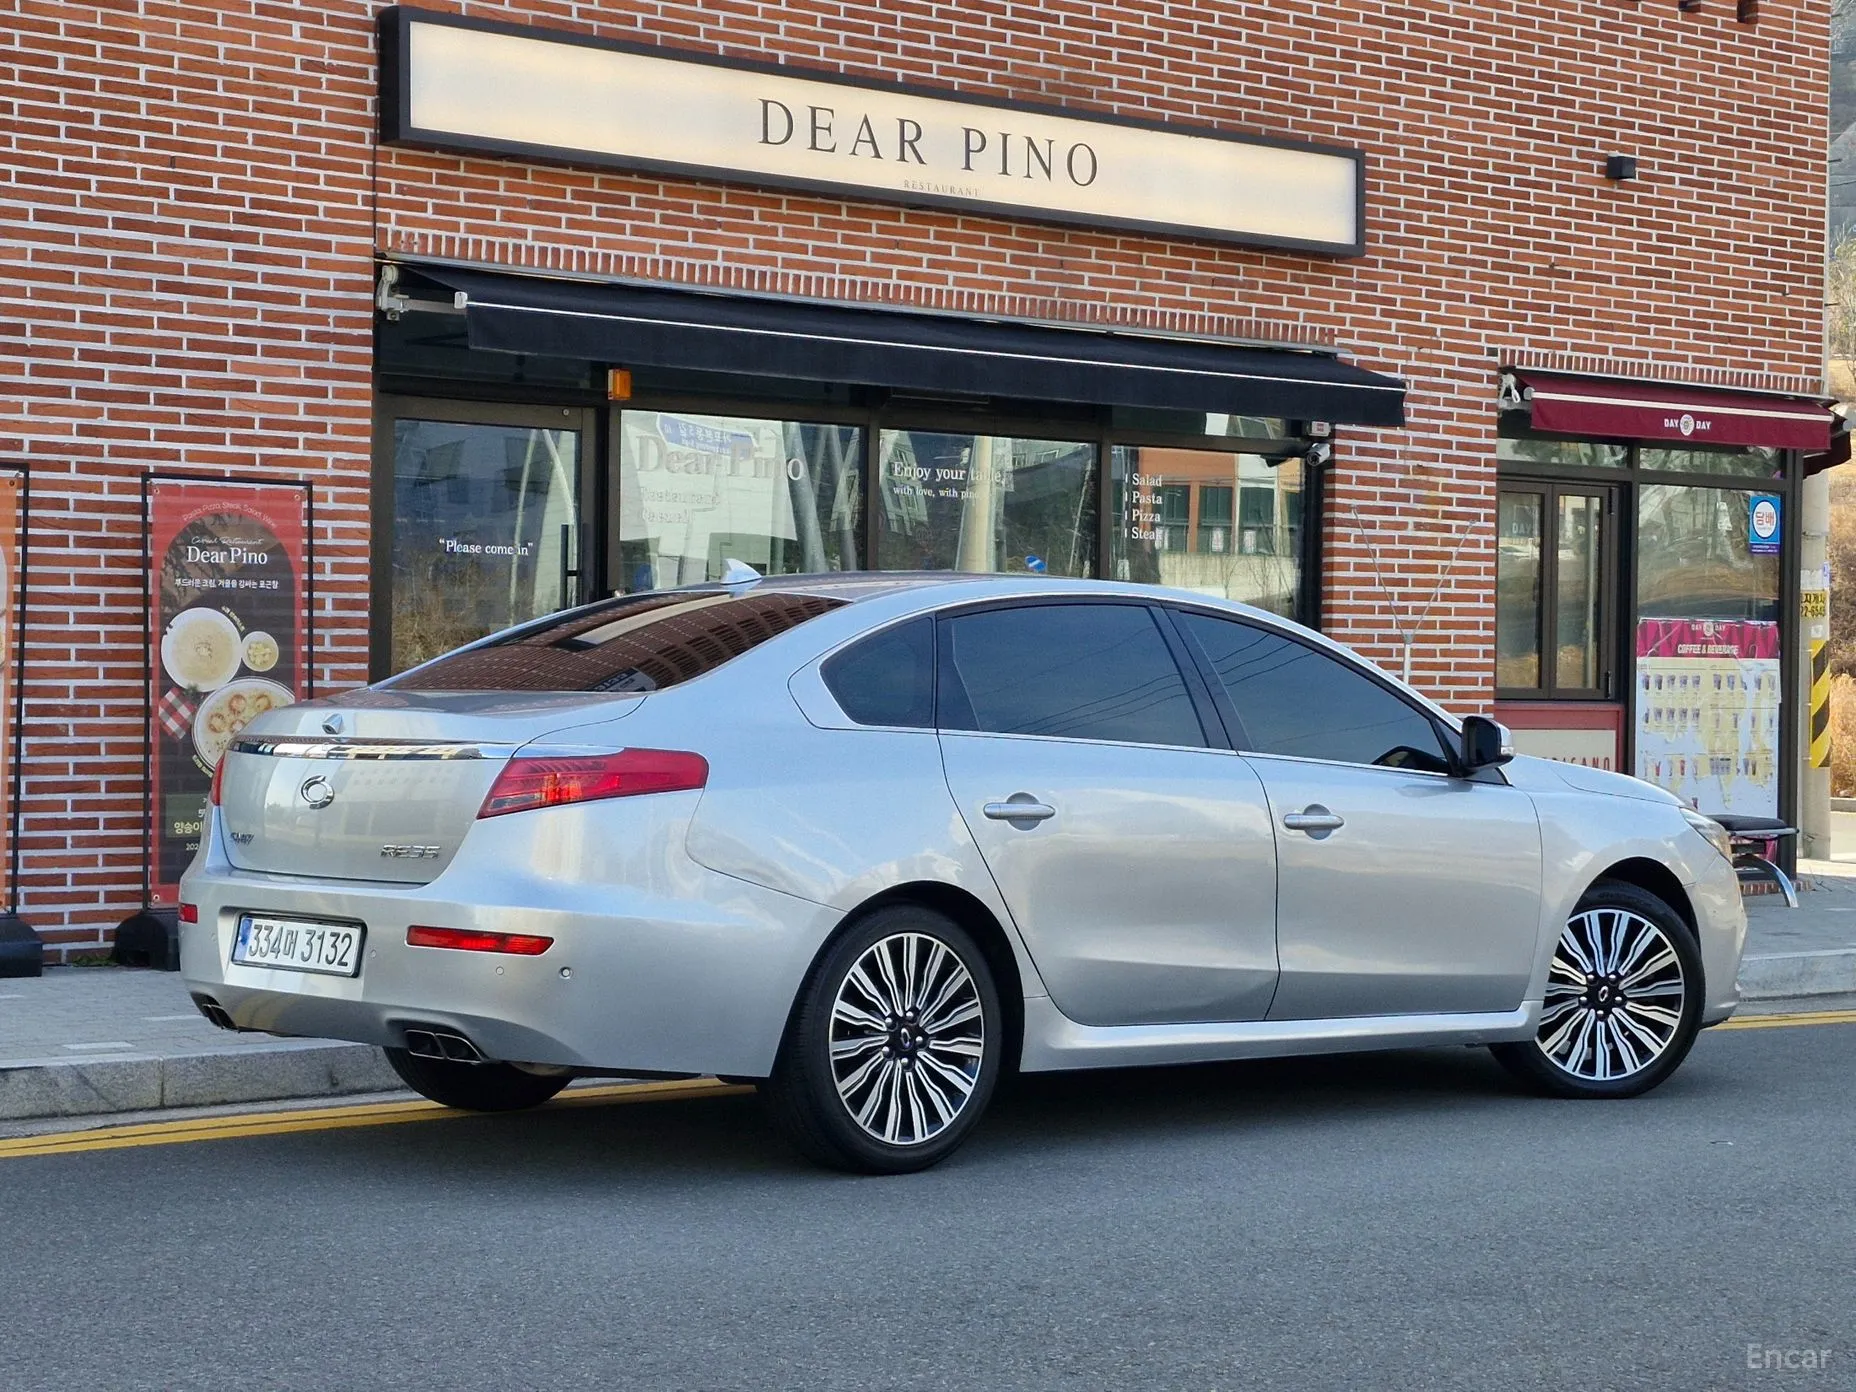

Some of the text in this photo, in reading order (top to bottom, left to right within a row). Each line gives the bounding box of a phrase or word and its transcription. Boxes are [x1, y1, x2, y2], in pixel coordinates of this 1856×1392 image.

[758, 98, 1097, 187] DEAR PINO
[903, 179, 982, 197] RESTAURANT
[1664, 418, 1712, 430] DAY DAY
[636, 434, 714, 475] Dear
[728, 440, 804, 481] Pino
[893, 462, 931, 481] Enjoy
[936, 468, 967, 482] your
[1131, 473, 1162, 487] Salad
[893, 486, 913, 497] with
[915, 487, 936, 498] love,
[938, 487, 958, 498] with
[1131, 491, 1162, 505] Pasta
[1131, 508, 1161, 522] Pizza
[1756, 511, 1775, 527] 담배
[1131, 526, 1163, 540] Steak
[186, 545, 268, 564] Dear Pino
[485, 545, 514, 555] come
[1677, 643, 1702, 654] COFFEE
[1707, 644, 1740, 655] BEVERAGE
[249, 924, 352, 967] 334머 3132
